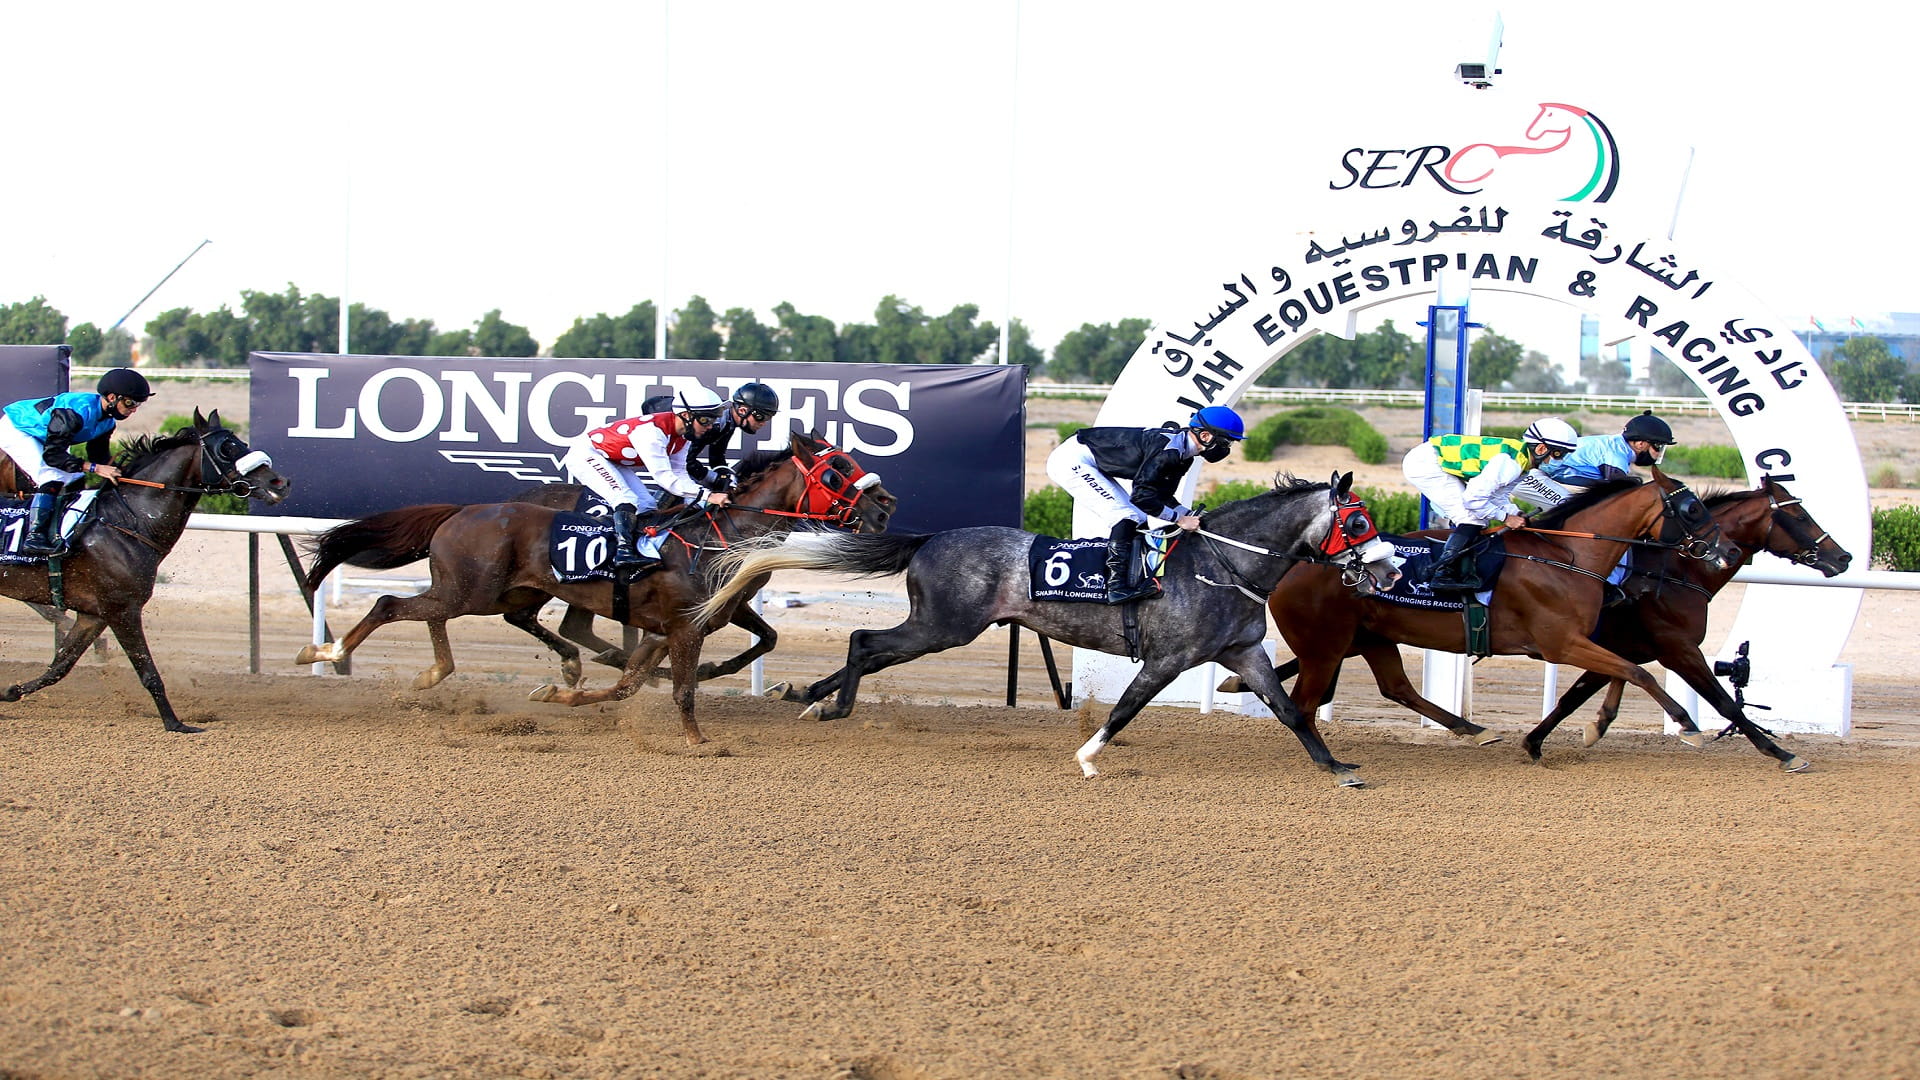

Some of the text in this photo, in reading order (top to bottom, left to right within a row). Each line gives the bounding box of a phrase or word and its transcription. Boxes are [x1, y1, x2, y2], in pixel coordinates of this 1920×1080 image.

[1329, 143, 1494, 195] SERC
[1541, 210, 1714, 300] الشارقة
[1271, 266, 1292, 295] و
[1151, 273, 1258, 378] السباق
[1253, 252, 1539, 347] EQUESTRIAN
[1567, 270, 1597, 298] &
[1624, 295, 1765, 417] RACING
[1719, 318, 1808, 391] نادي
[1081, 472, 1115, 501] Mazur
[556, 535, 608, 572] 10
[1044, 551, 1073, 587] 6
[1064, 591, 1103, 599] LONGINES
[1395, 595, 1432, 607] LONGINES
